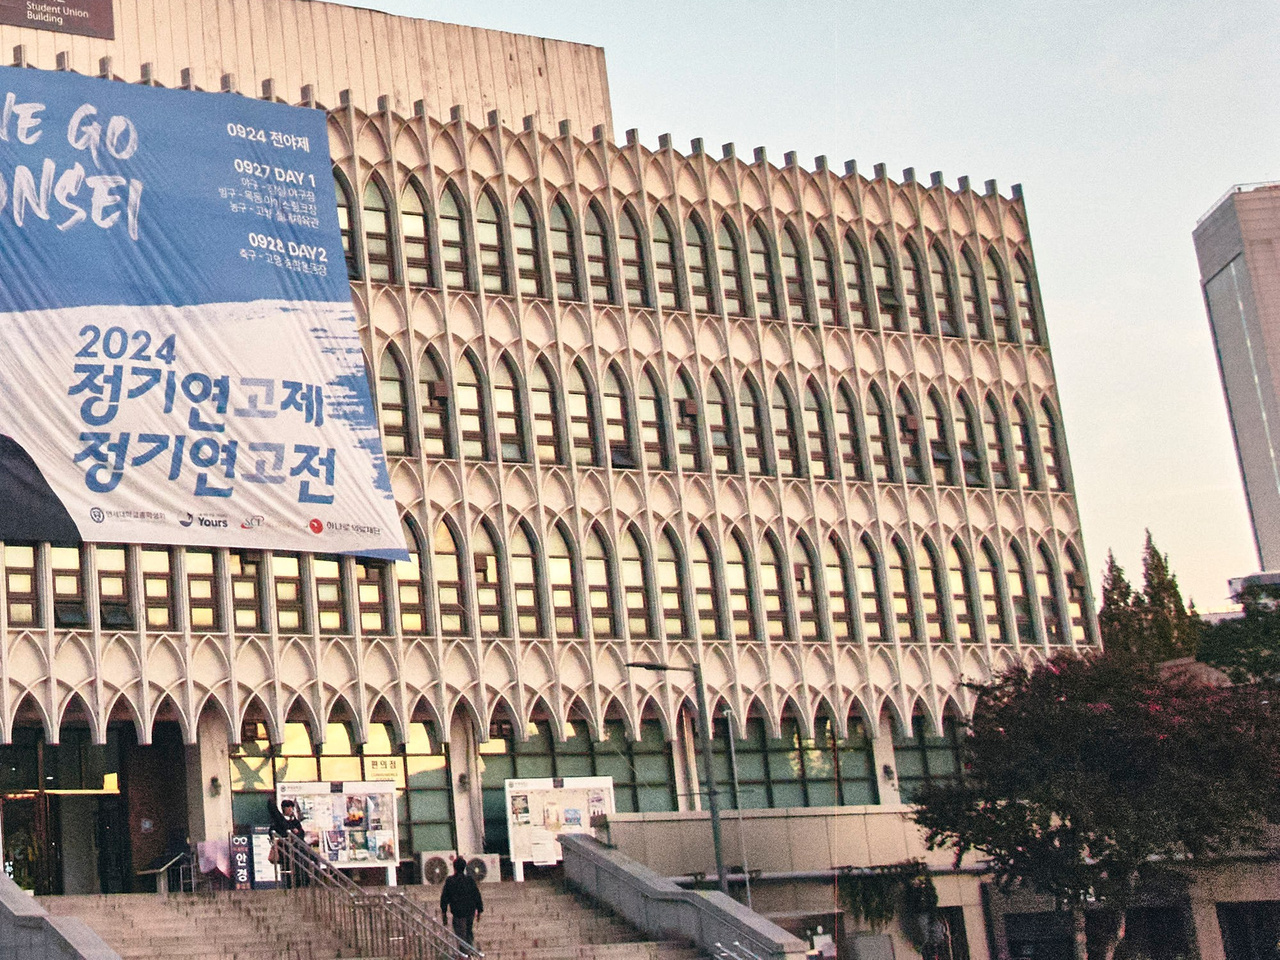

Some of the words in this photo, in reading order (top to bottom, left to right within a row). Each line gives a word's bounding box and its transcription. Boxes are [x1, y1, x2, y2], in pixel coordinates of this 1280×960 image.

[26, 1, 61, 14] Student
[62, 8, 89, 19] Union
[27, 11, 63, 25] Building
[67, 103, 139, 167] GO
[226, 122, 267, 144] 0924
[270, 130, 310, 153] 전야제
[234, 158, 271, 179] 0927
[274, 168, 305, 186] DAY
[308, 174, 316, 188] 1
[248, 232, 285, 253] 0928
[75, 324, 176, 366] 2024
[68, 362, 324, 434] 정기연고제
[73, 431, 337, 506] 정기연고전
[198, 516, 229, 528] Yours
